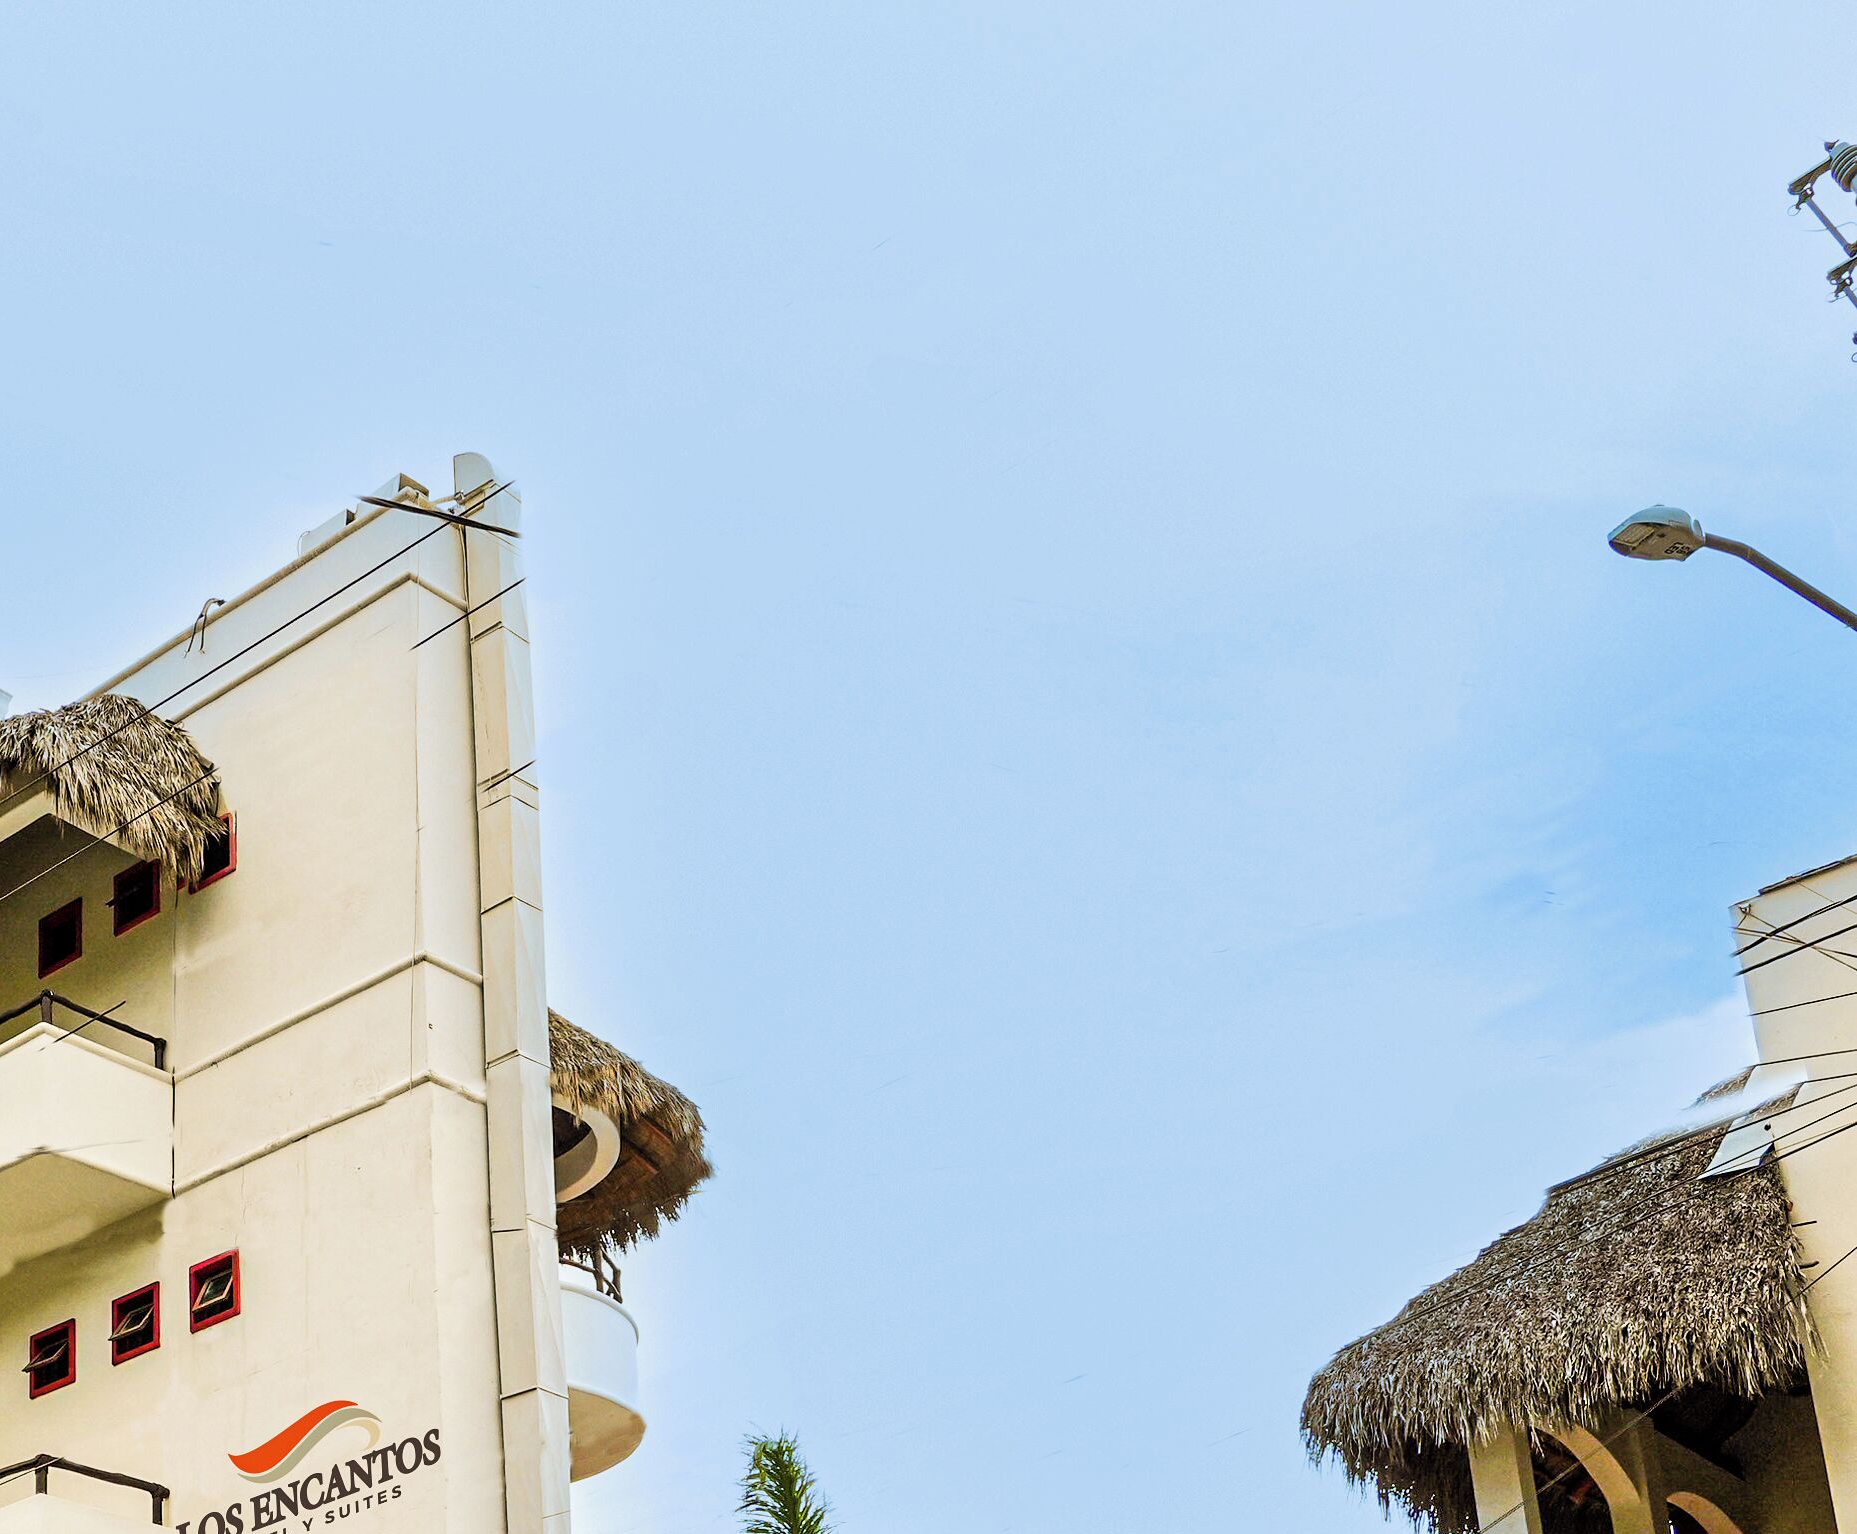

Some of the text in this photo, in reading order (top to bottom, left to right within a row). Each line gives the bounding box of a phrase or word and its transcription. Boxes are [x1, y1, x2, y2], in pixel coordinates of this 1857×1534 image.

[250, 1428, 441, 1532] ENCANTOS
[302, 1517, 314, 1532] Y
[324, 1485, 402, 1524] SUITES
